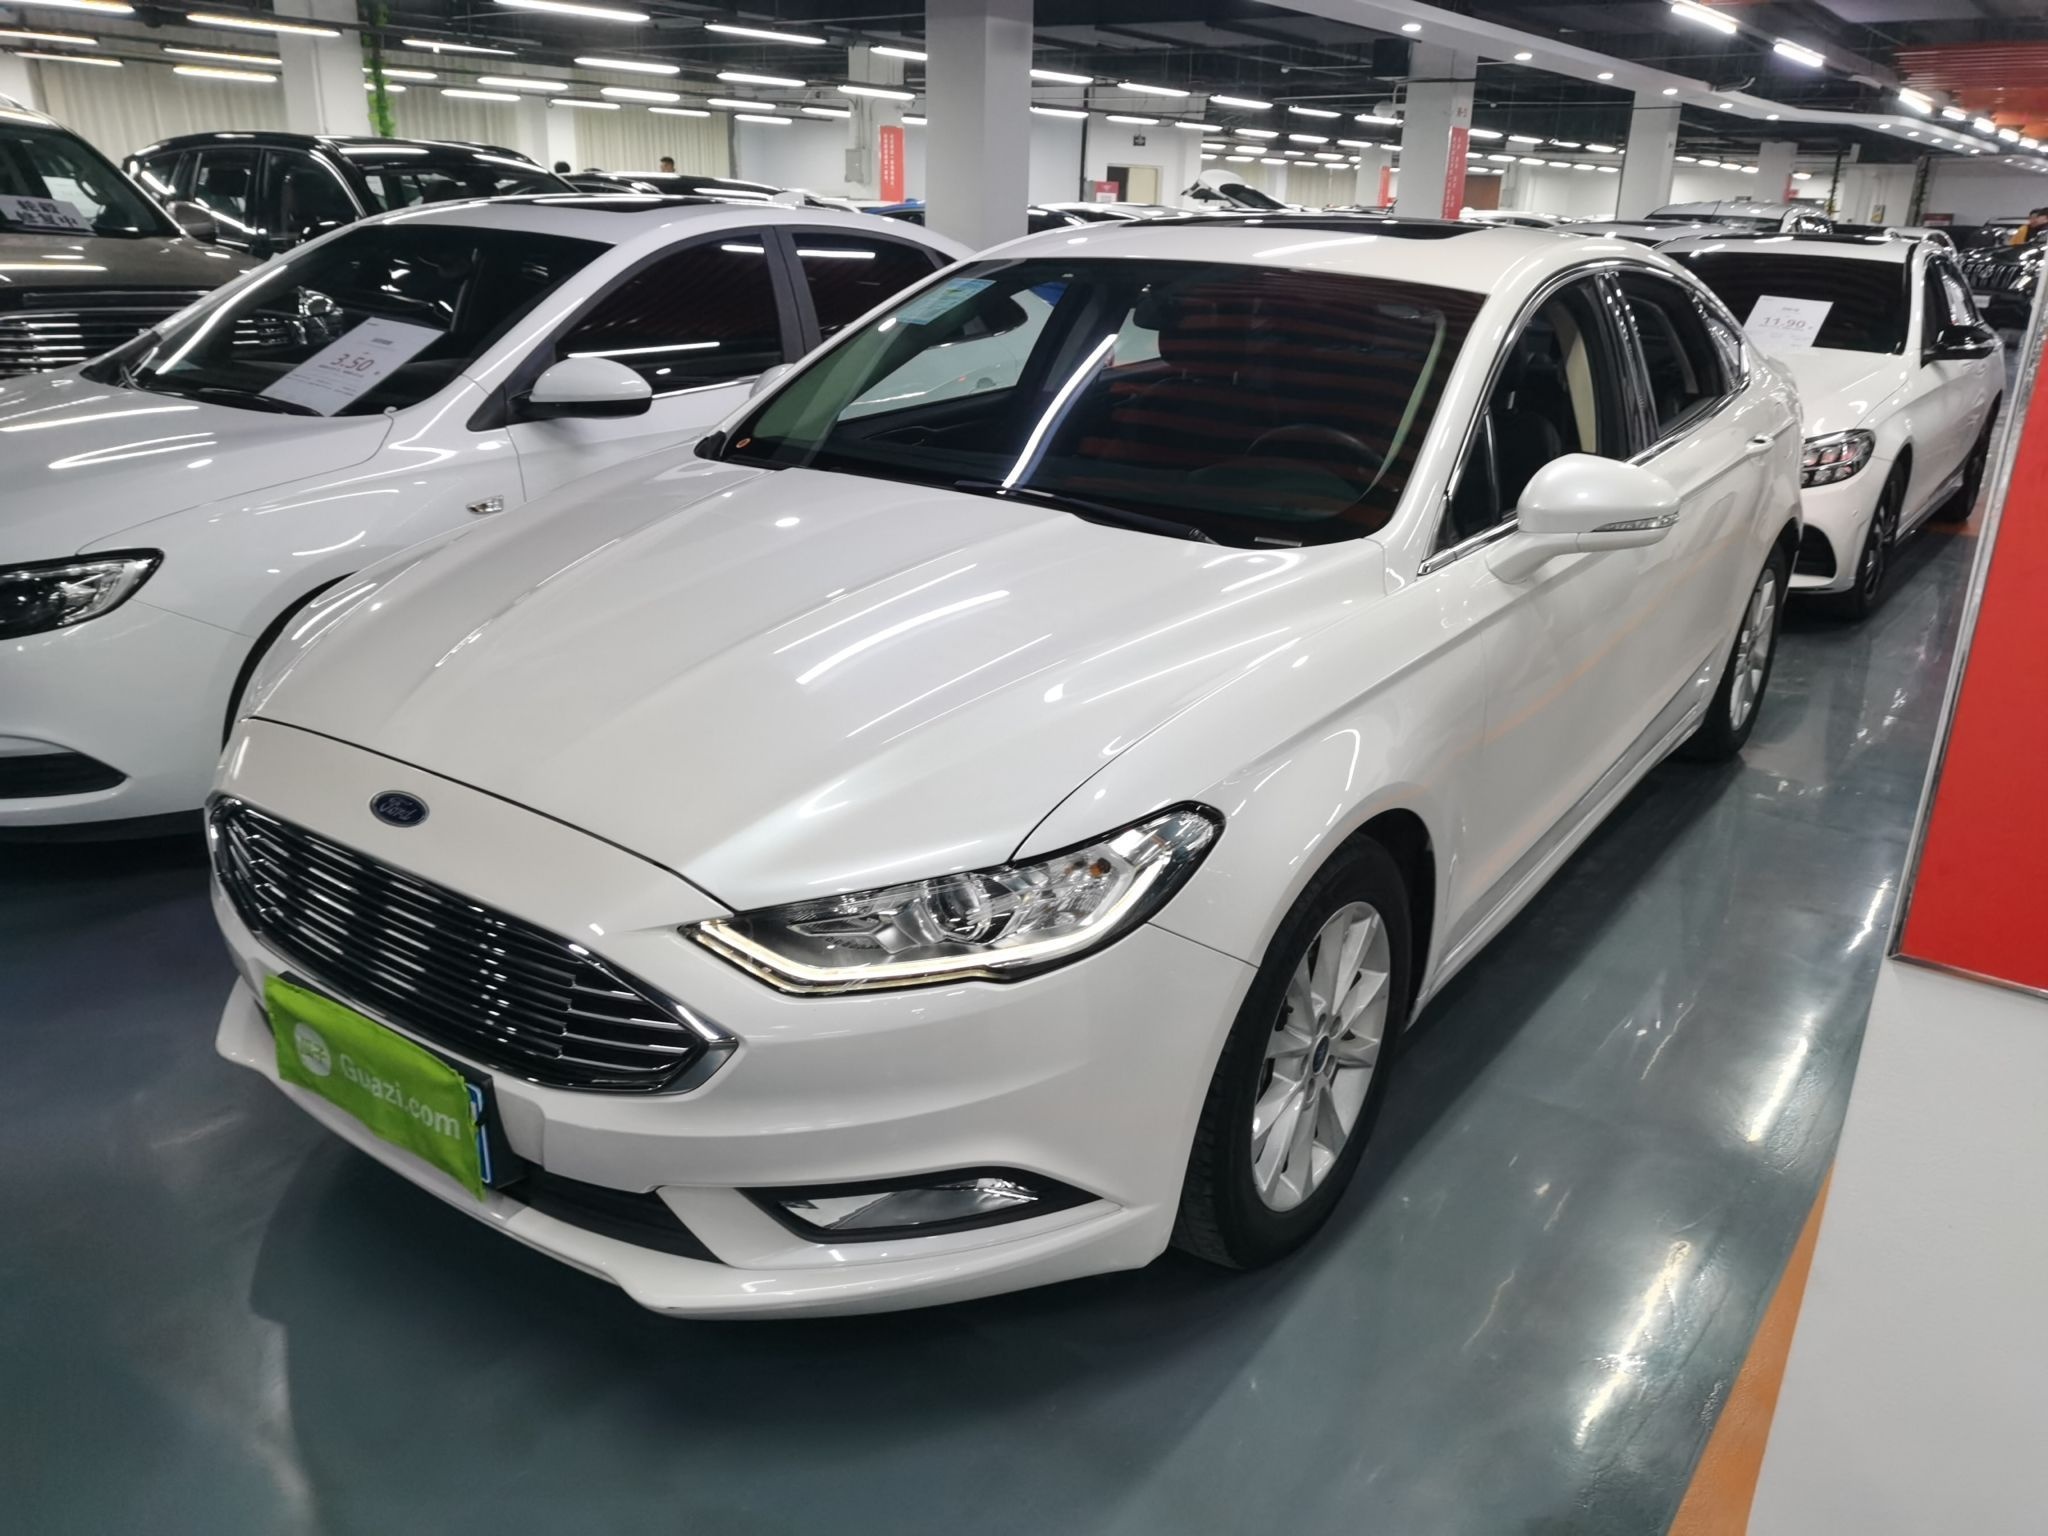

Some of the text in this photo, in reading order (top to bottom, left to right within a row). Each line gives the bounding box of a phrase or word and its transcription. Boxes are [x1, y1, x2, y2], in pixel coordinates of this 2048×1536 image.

[1763, 316, 1807, 329] 11.90
[330, 353, 375, 373] 3.50
[378, 796, 419, 821] Ford
[339, 1053, 462, 1140] Guazi.com
